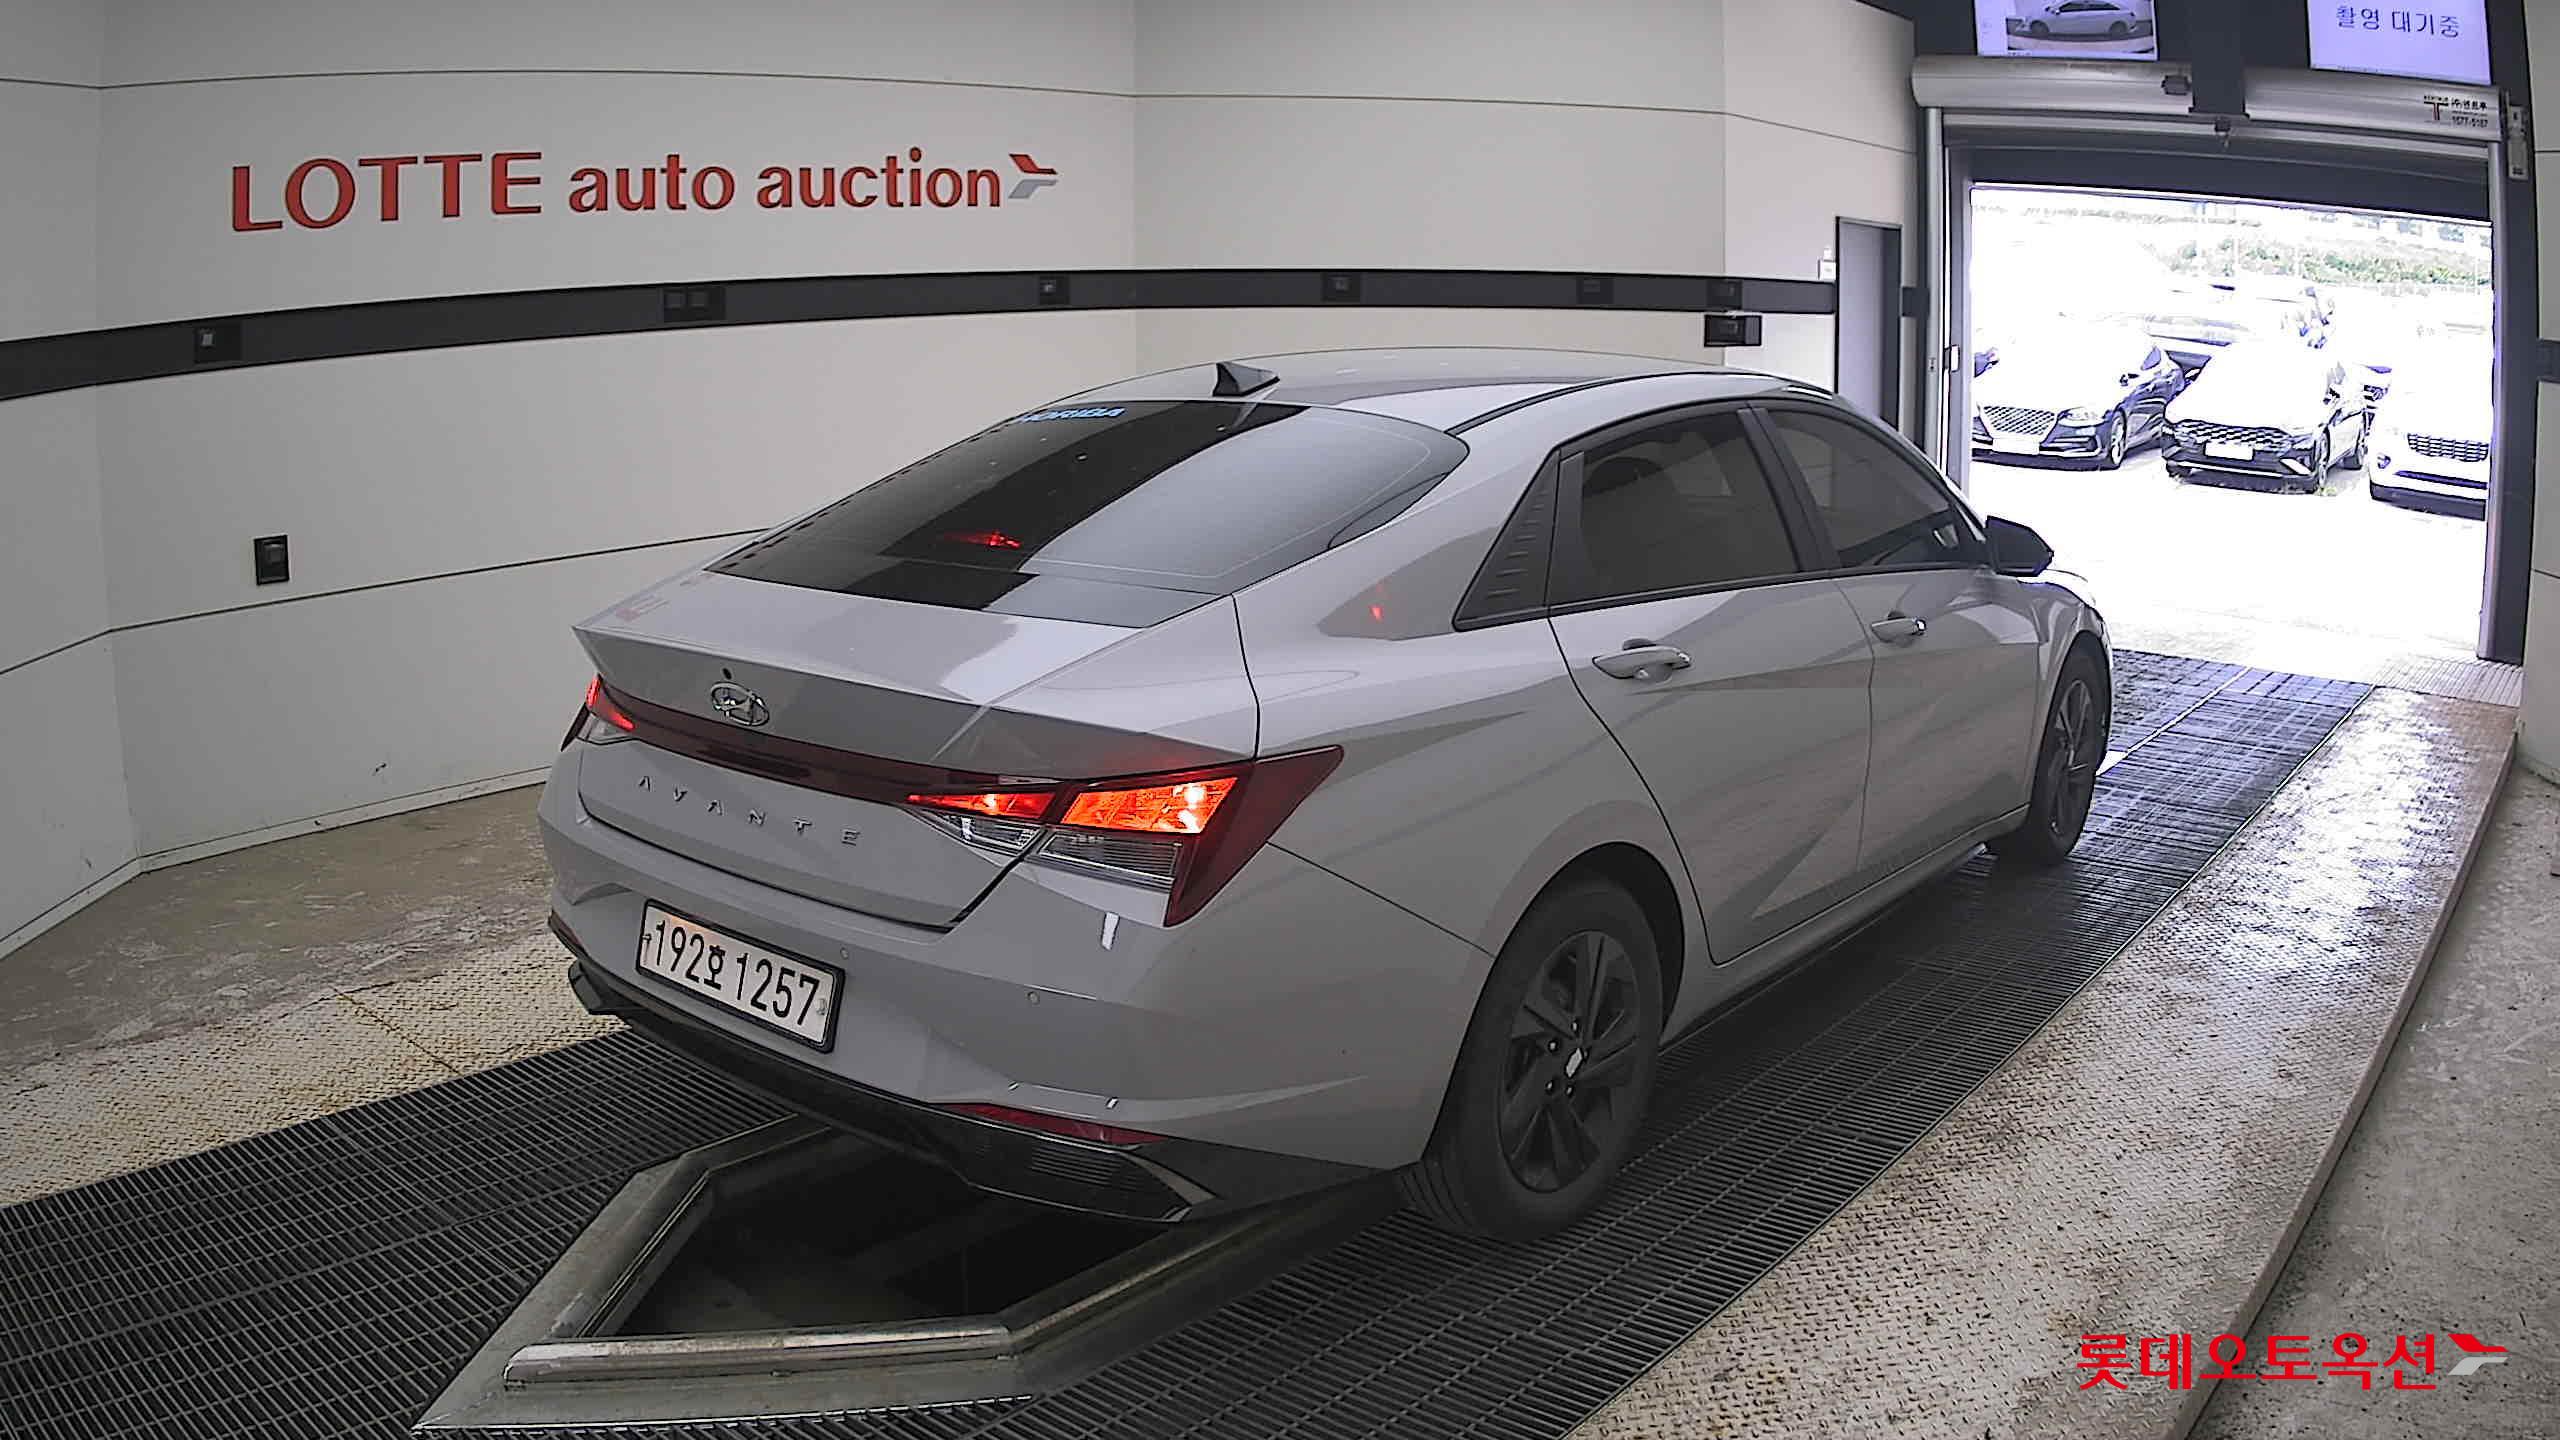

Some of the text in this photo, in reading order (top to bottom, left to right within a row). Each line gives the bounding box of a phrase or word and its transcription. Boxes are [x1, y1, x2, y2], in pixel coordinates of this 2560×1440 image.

[2336, 5, 2459, 38] 촬영 대기중
[232, 146, 1001, 232] LOTTE auto auction
[637, 775, 861, 847] AVANTE
